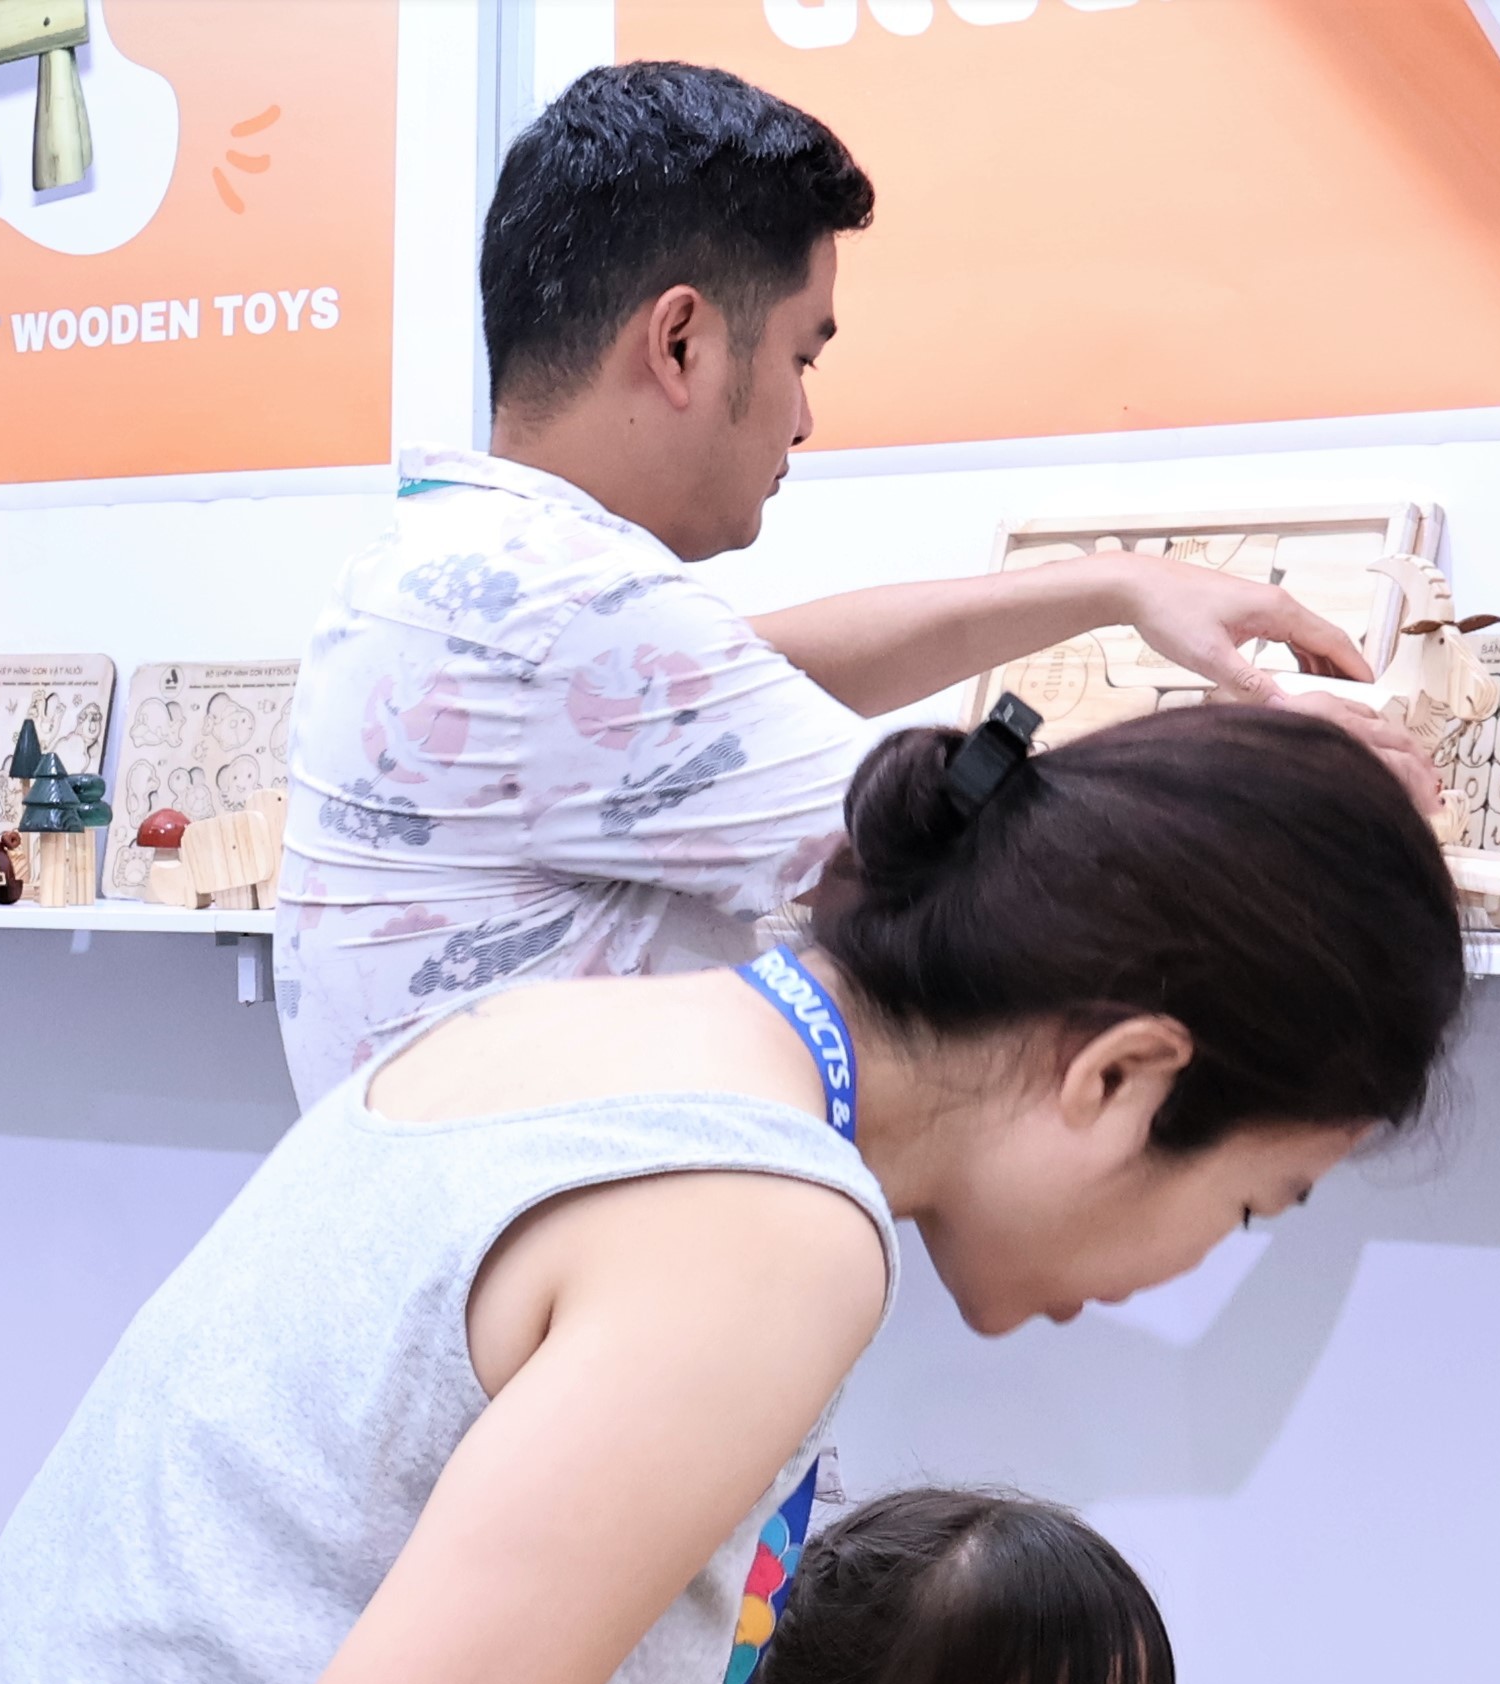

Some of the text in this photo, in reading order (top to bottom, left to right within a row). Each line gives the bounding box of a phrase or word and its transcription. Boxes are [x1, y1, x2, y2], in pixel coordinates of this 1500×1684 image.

[11, 298, 199, 353] WOODEN
[213, 286, 340, 337] TOYS
[751, 949, 851, 1091] RODUCTS
